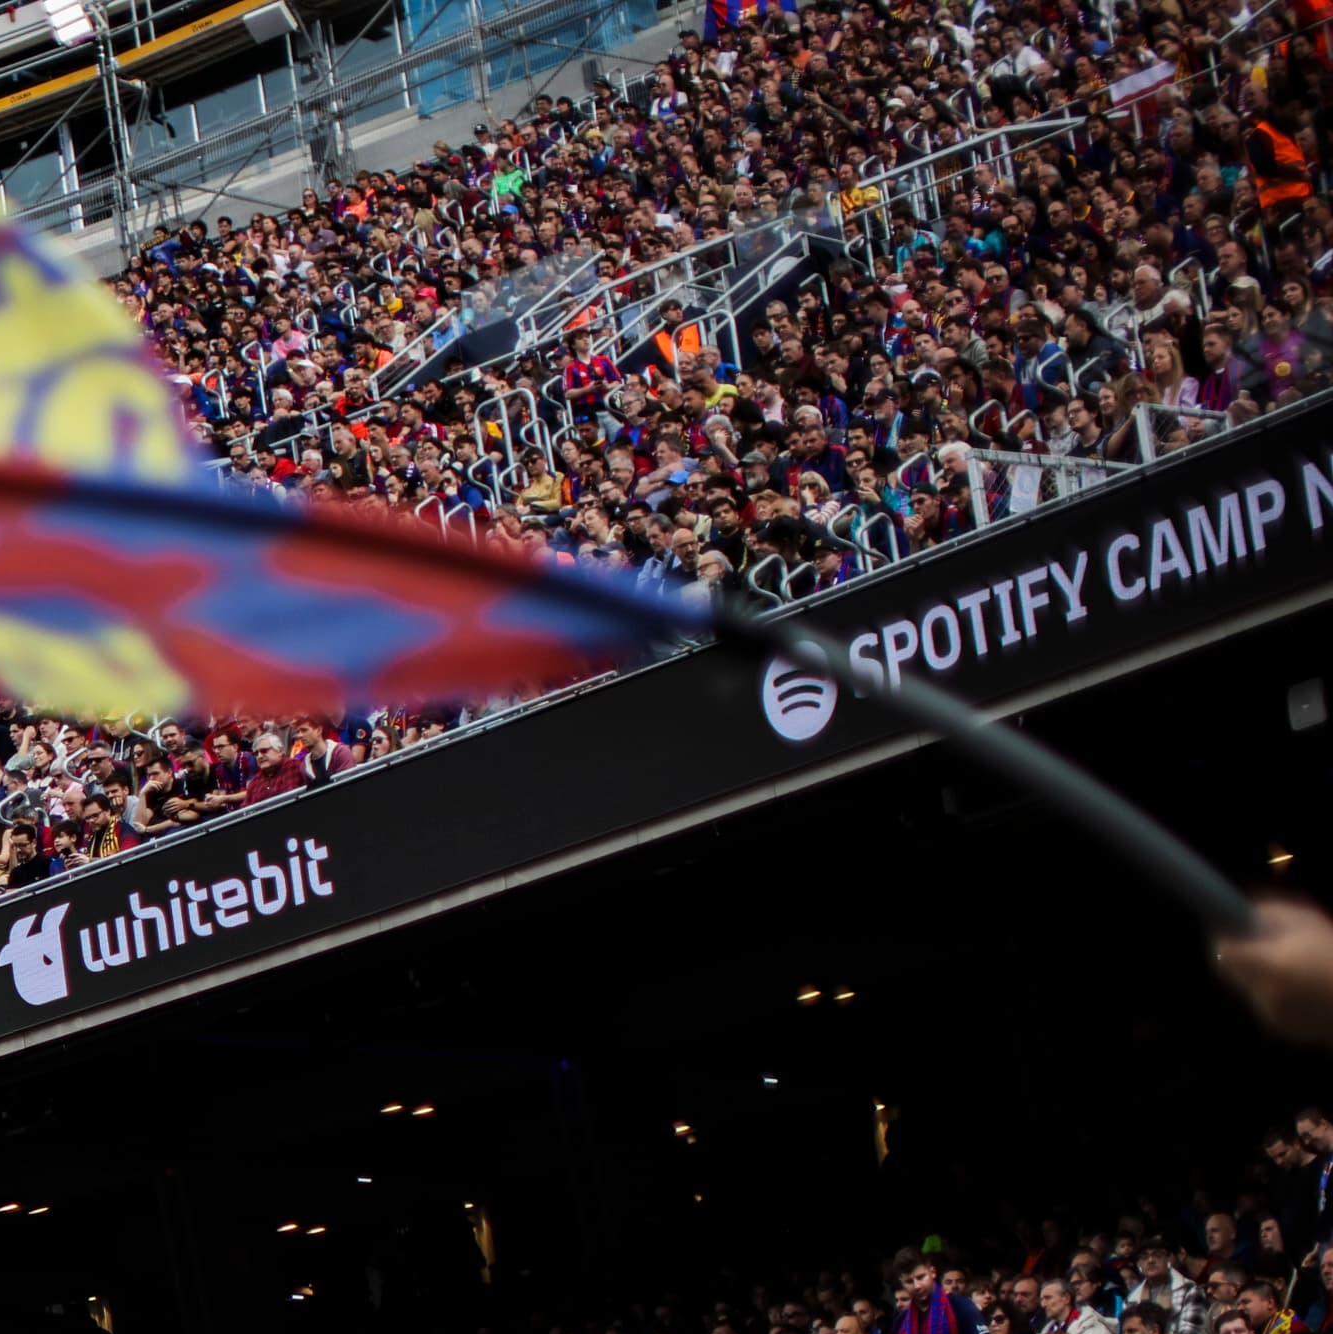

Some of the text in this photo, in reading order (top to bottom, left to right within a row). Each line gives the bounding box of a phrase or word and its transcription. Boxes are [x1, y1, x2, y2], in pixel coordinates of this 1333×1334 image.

[848, 551, 1089, 698] SPOTIFY
[1107, 478, 1286, 601] CAMP
[78, 838, 333, 973] whitebit
